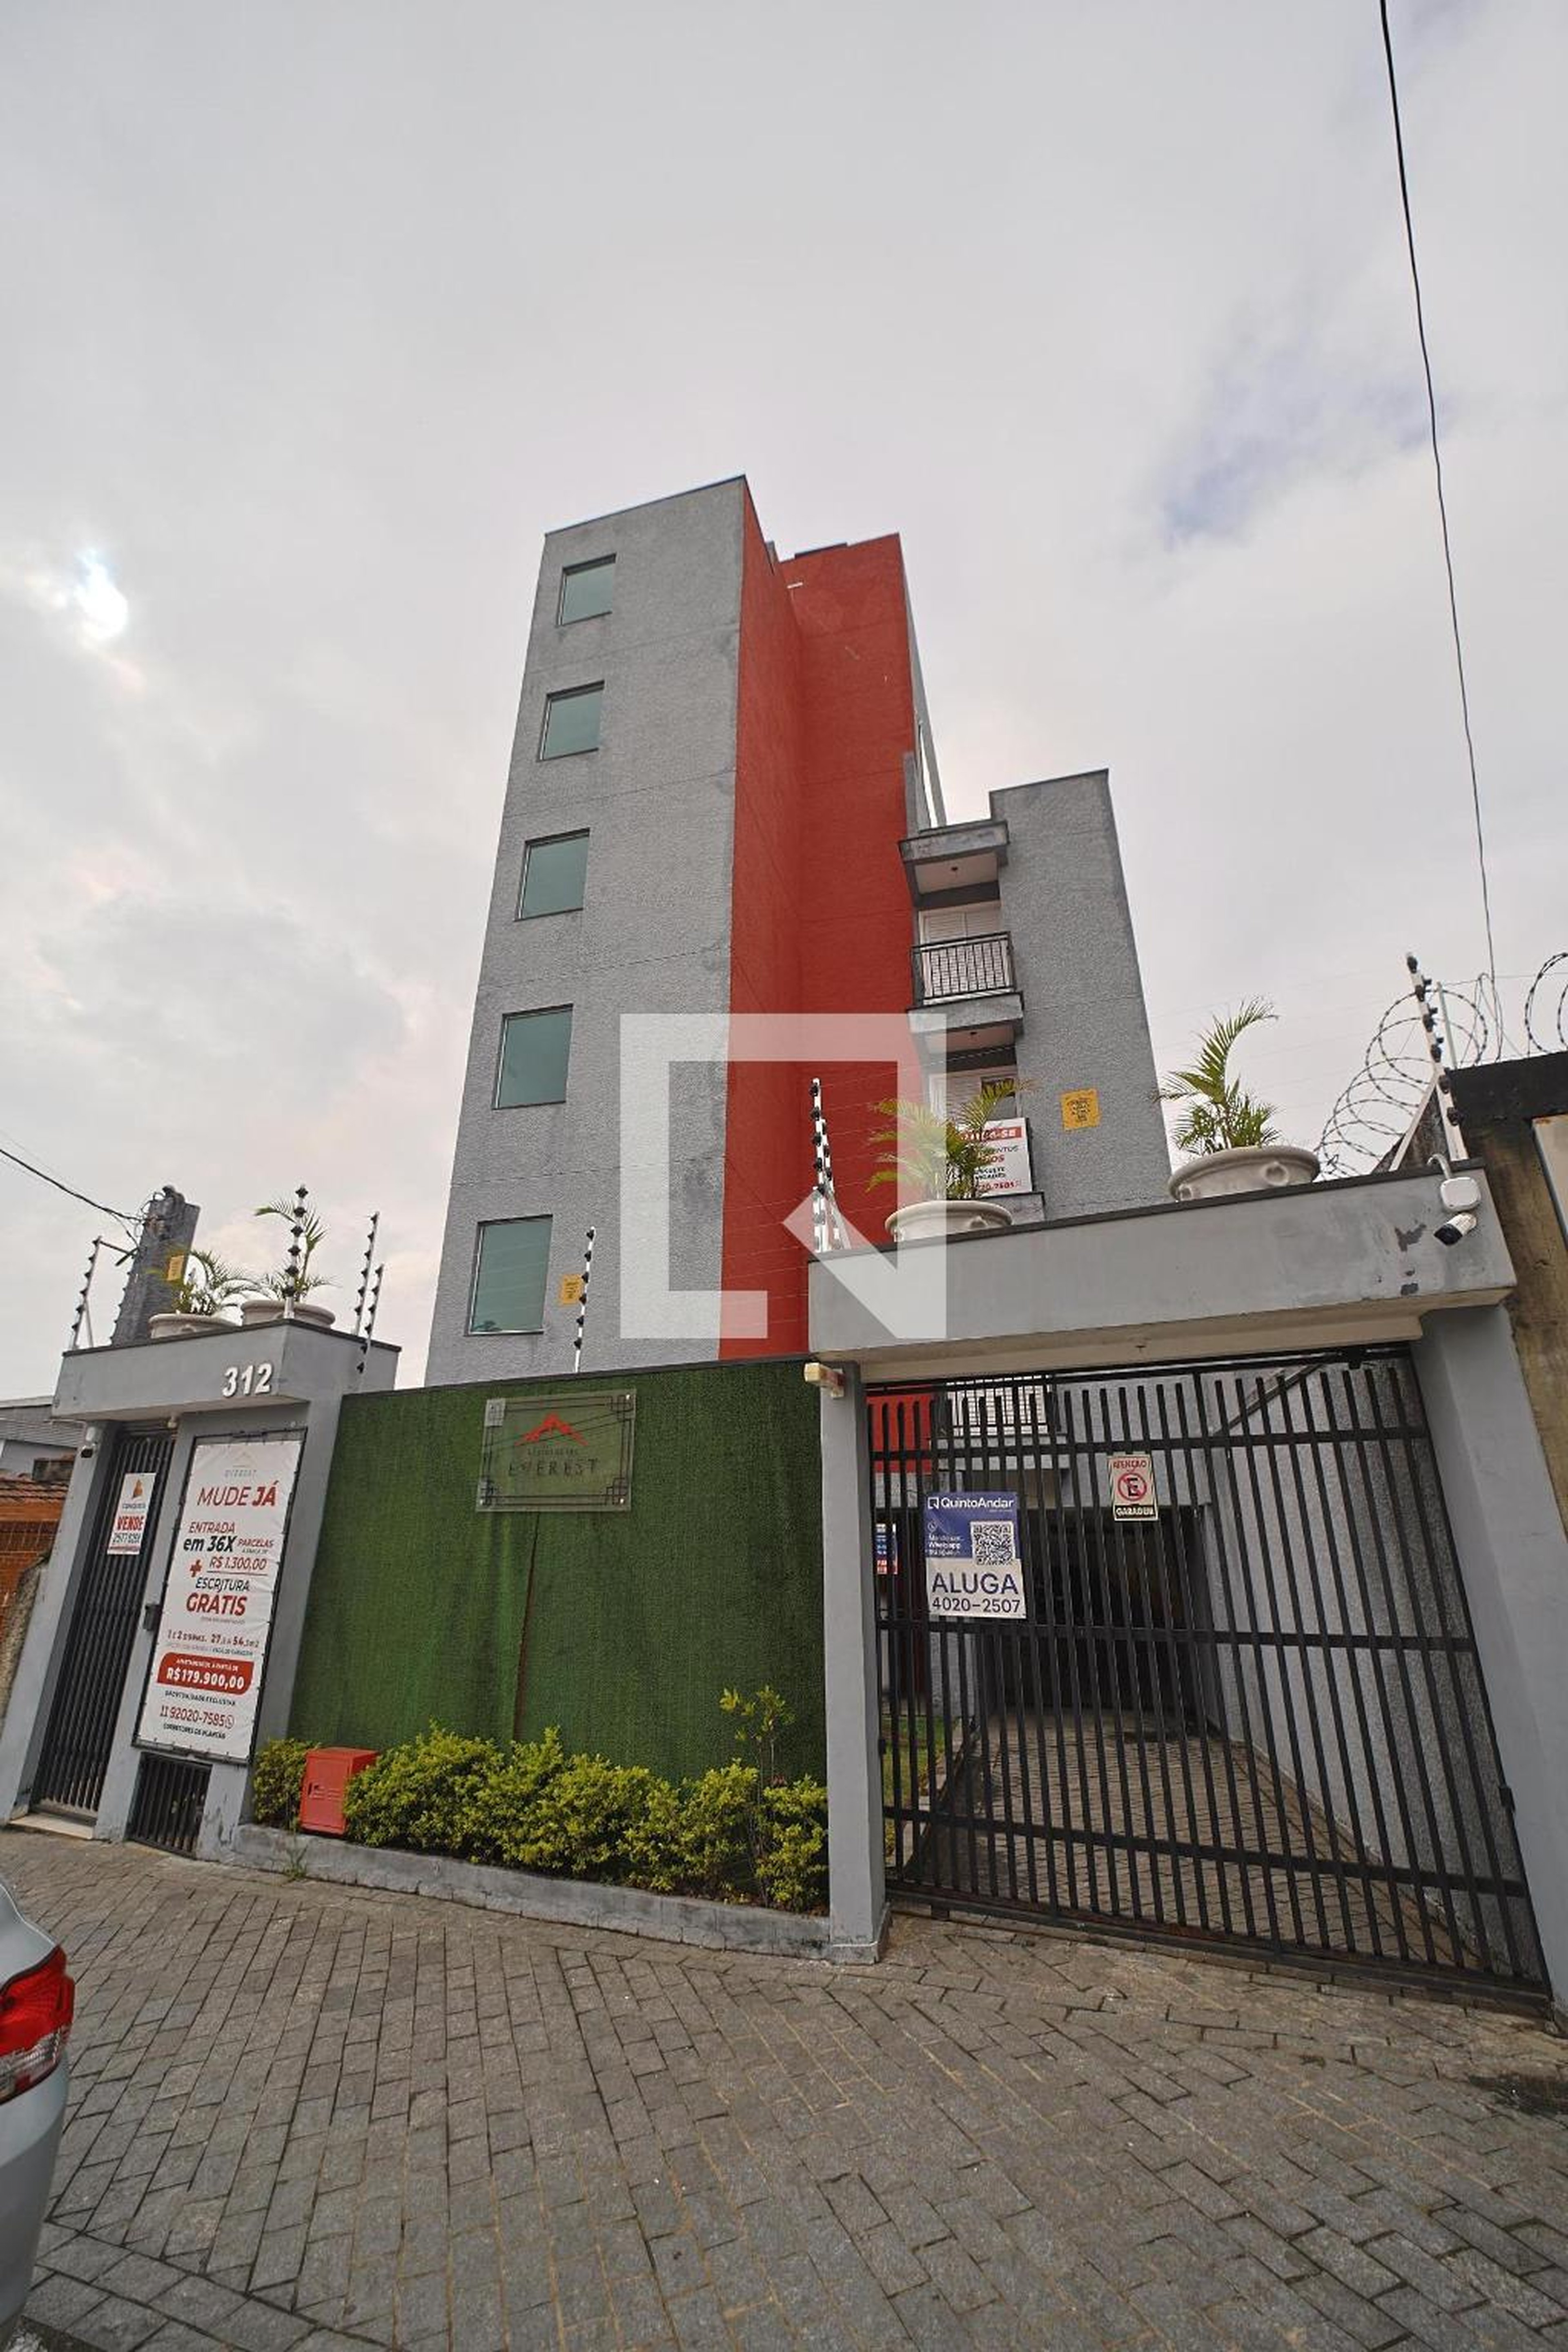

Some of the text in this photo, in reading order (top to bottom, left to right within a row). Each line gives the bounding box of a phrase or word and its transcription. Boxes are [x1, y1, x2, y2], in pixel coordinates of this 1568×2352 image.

[222, 1363, 273, 1397] 312
[197, 1480, 279, 1506] MUDE JÁ
[941, 1497, 1014, 1508] QuintoAndar
[118, 1516, 145, 1530] VENDE
[188, 1521, 235, 1533] ENTRADA
[184, 1536, 237, 1552] em 36X
[237, 1539, 274, 1548] PARCELAS
[196, 1577, 250, 1591] ESCRITURA
[932, 1572, 1019, 1595] ALUGA
[932, 1597, 1020, 1613] 4020-2507
